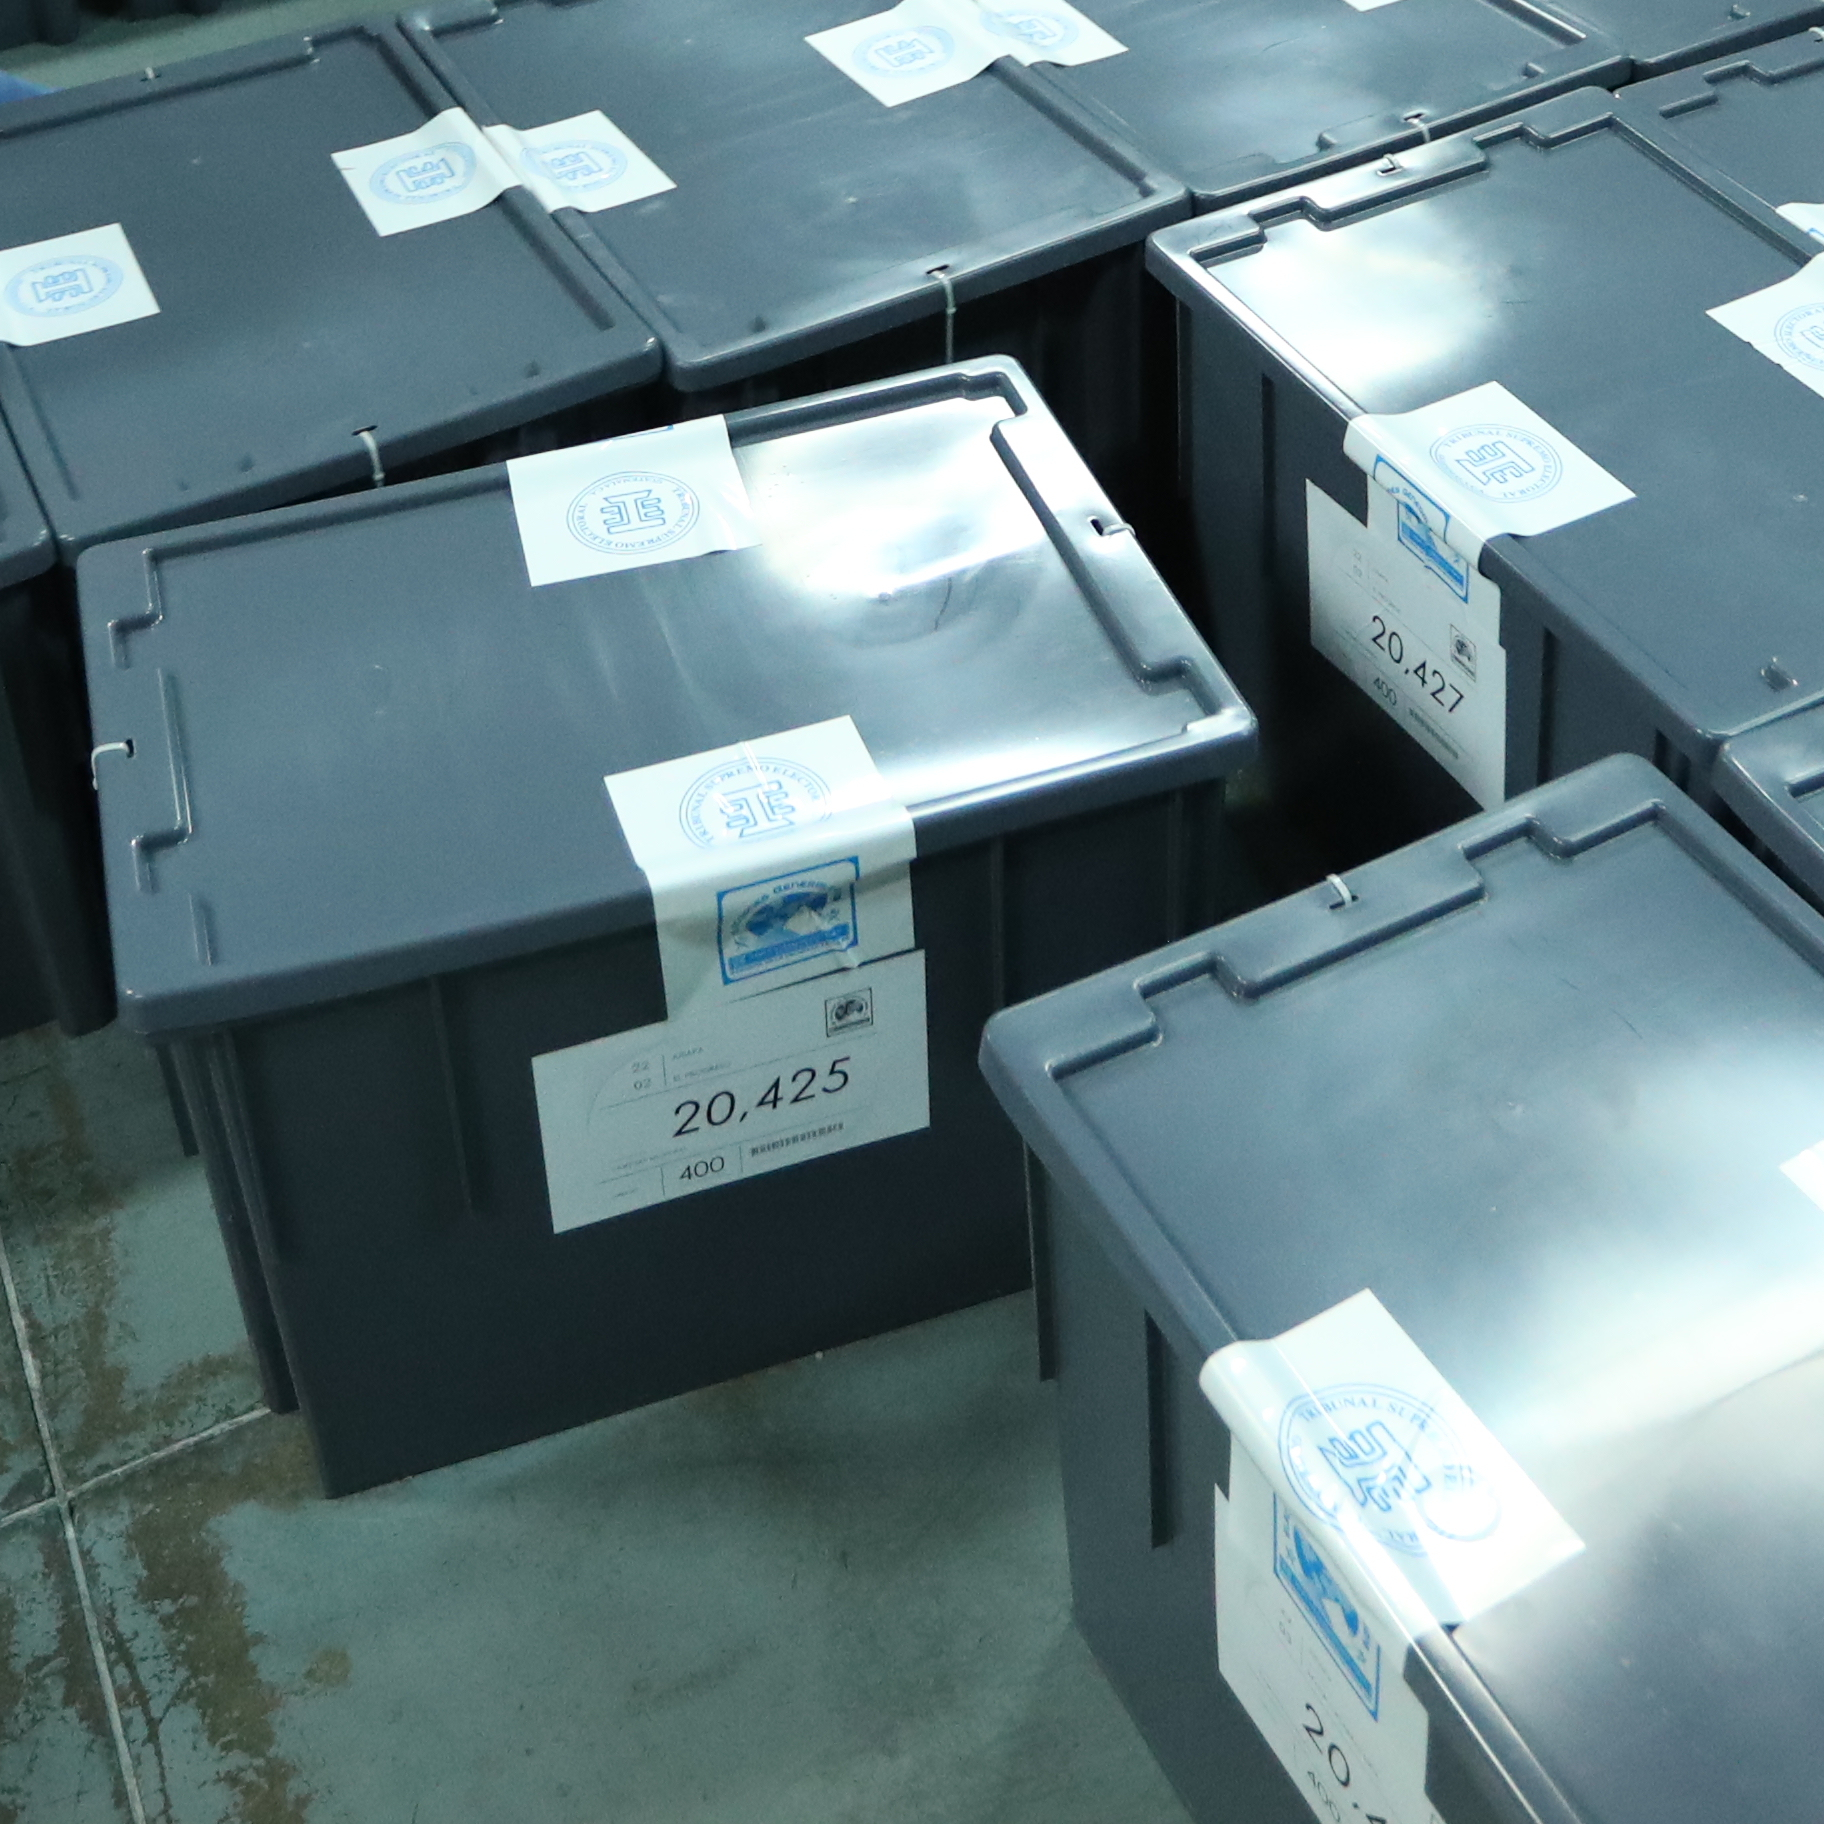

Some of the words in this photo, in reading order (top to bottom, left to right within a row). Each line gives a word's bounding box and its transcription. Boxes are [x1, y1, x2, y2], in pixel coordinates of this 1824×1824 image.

[1371, 614, 1465, 713] 20,427
[1373, 677, 1397, 706] 400
[672, 1055, 851, 1139] 20,425
[679, 1155, 726, 1181] 400
